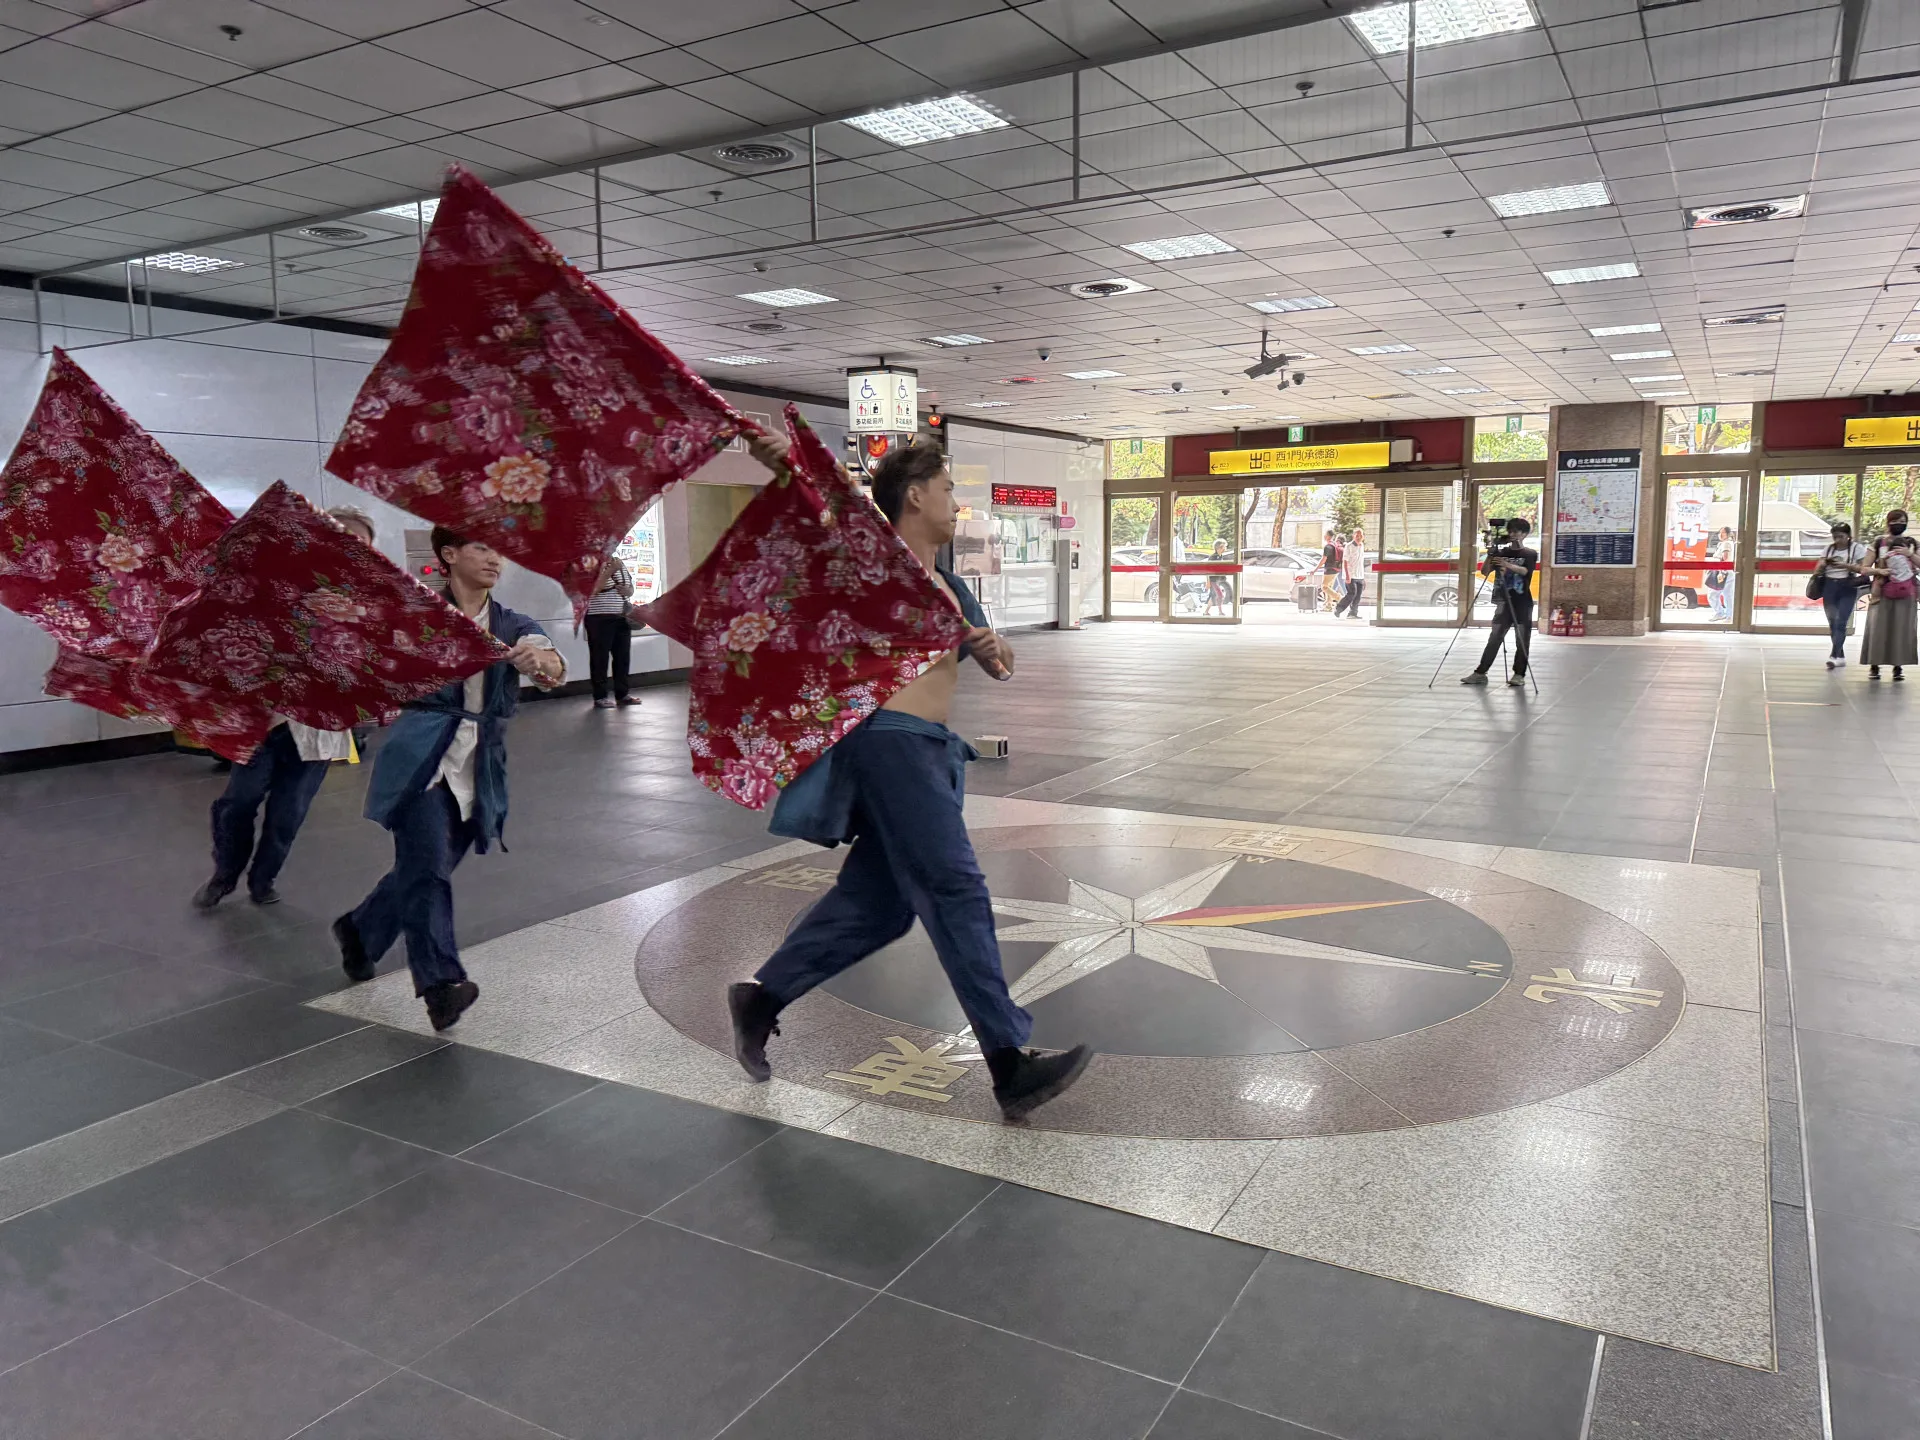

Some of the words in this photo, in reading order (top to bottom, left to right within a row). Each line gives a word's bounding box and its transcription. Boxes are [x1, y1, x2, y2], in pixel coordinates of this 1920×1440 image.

[1250, 451, 1271, 470] 出口
[1466, 960, 1504, 972] N
[1522, 967, 1665, 1015] 北
